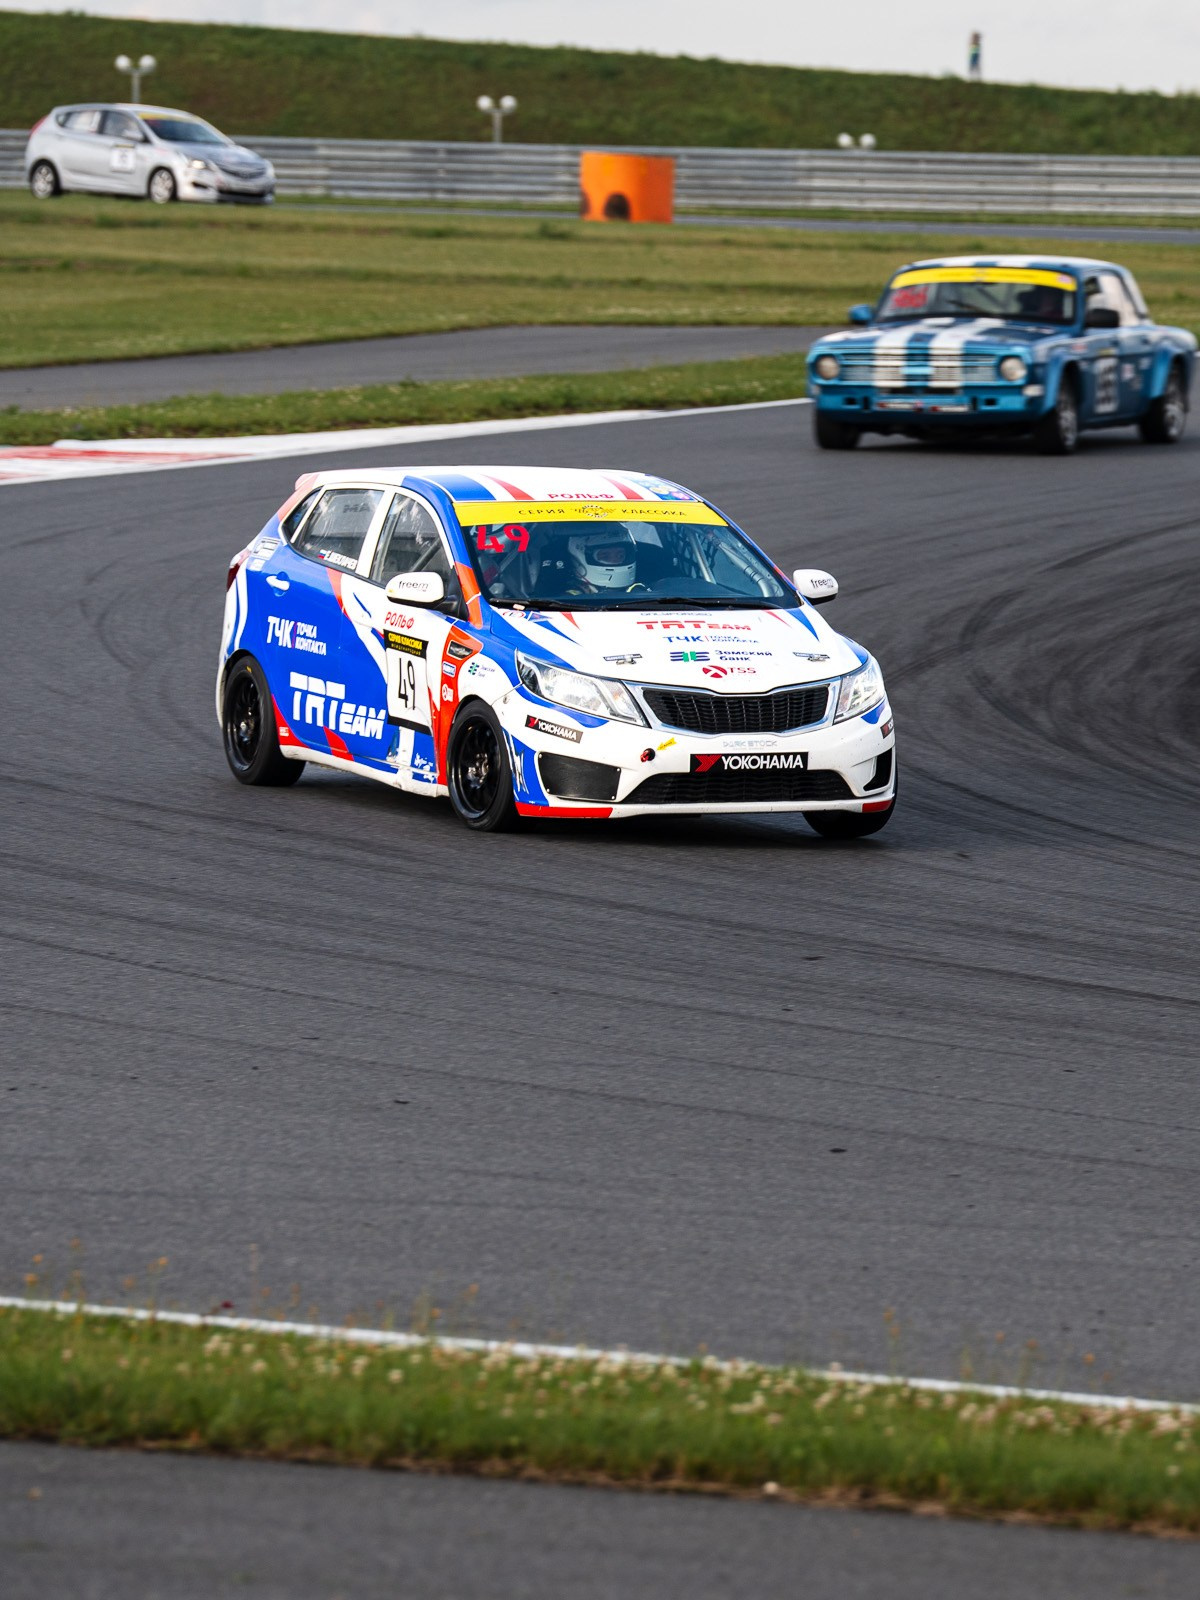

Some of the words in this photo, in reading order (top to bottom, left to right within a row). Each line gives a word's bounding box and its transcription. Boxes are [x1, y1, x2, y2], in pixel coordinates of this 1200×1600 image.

[518, 508, 565, 516] СЕРИЯ
[621, 508, 687, 516] КЛАССИКА
[476, 525, 530, 553] 49
[384, 611, 415, 630] РОЛЬФ
[267, 616, 293, 648] ТЧК
[296, 621, 318, 638] ТОЧКА
[662, 635, 703, 643] ТЧК
[295, 635, 327, 656] КОНТАКТА
[398, 656, 416, 711] 49
[538, 719, 578, 741] YOKOHAMA
[747, 739, 778, 747] STOCK
[721, 754, 804, 770] YOKOHAMA
